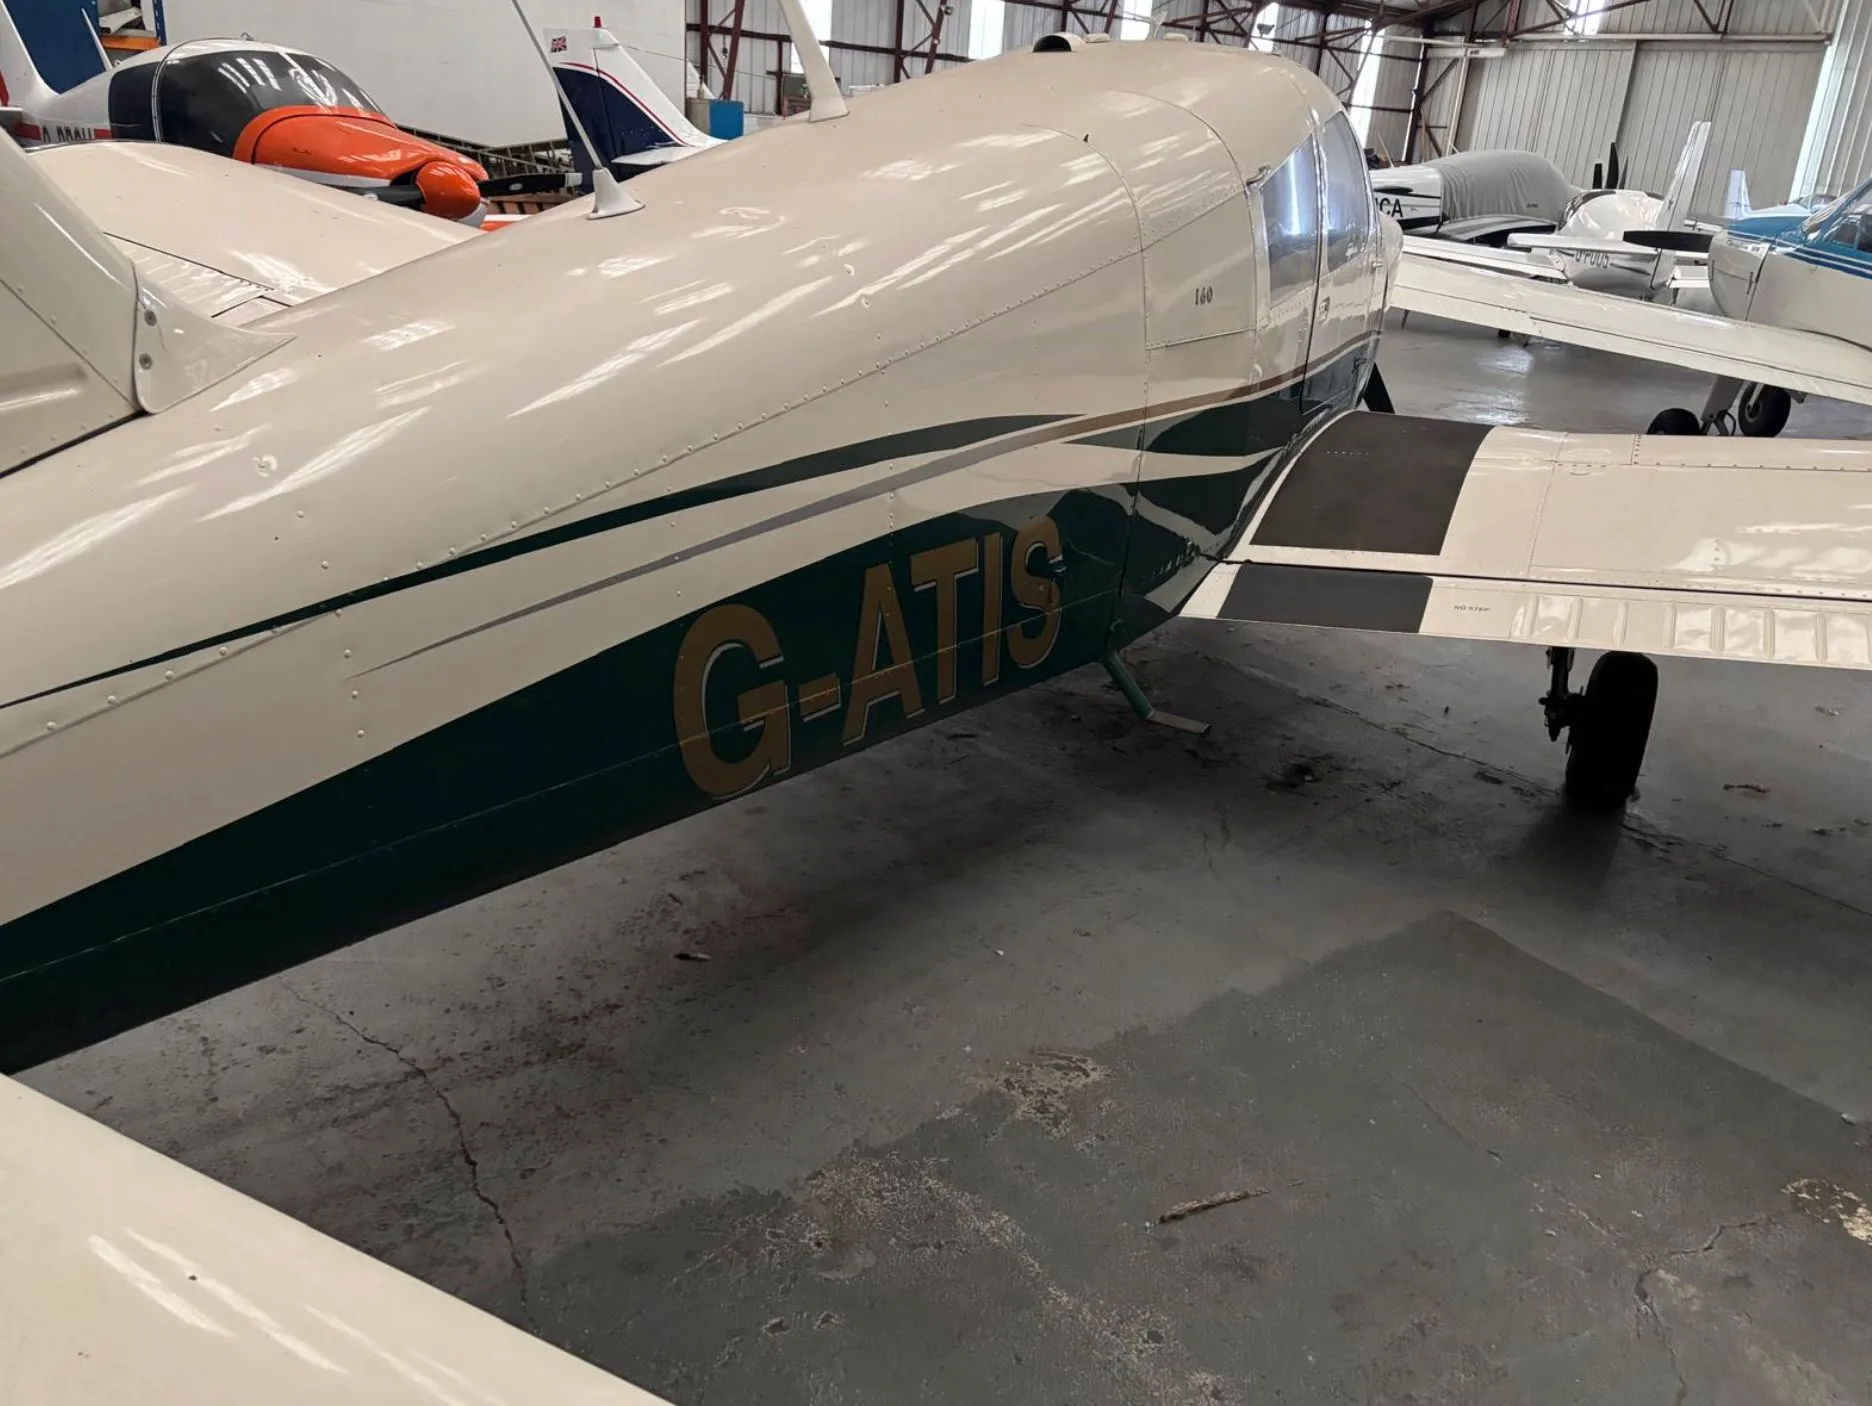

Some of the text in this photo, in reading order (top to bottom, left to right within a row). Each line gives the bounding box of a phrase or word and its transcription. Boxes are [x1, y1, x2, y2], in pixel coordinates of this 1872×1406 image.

[1374, 197, 1404, 218] CA
[1195, 286, 1213, 306] 160
[673, 514, 1064, 800] G-ATIS
